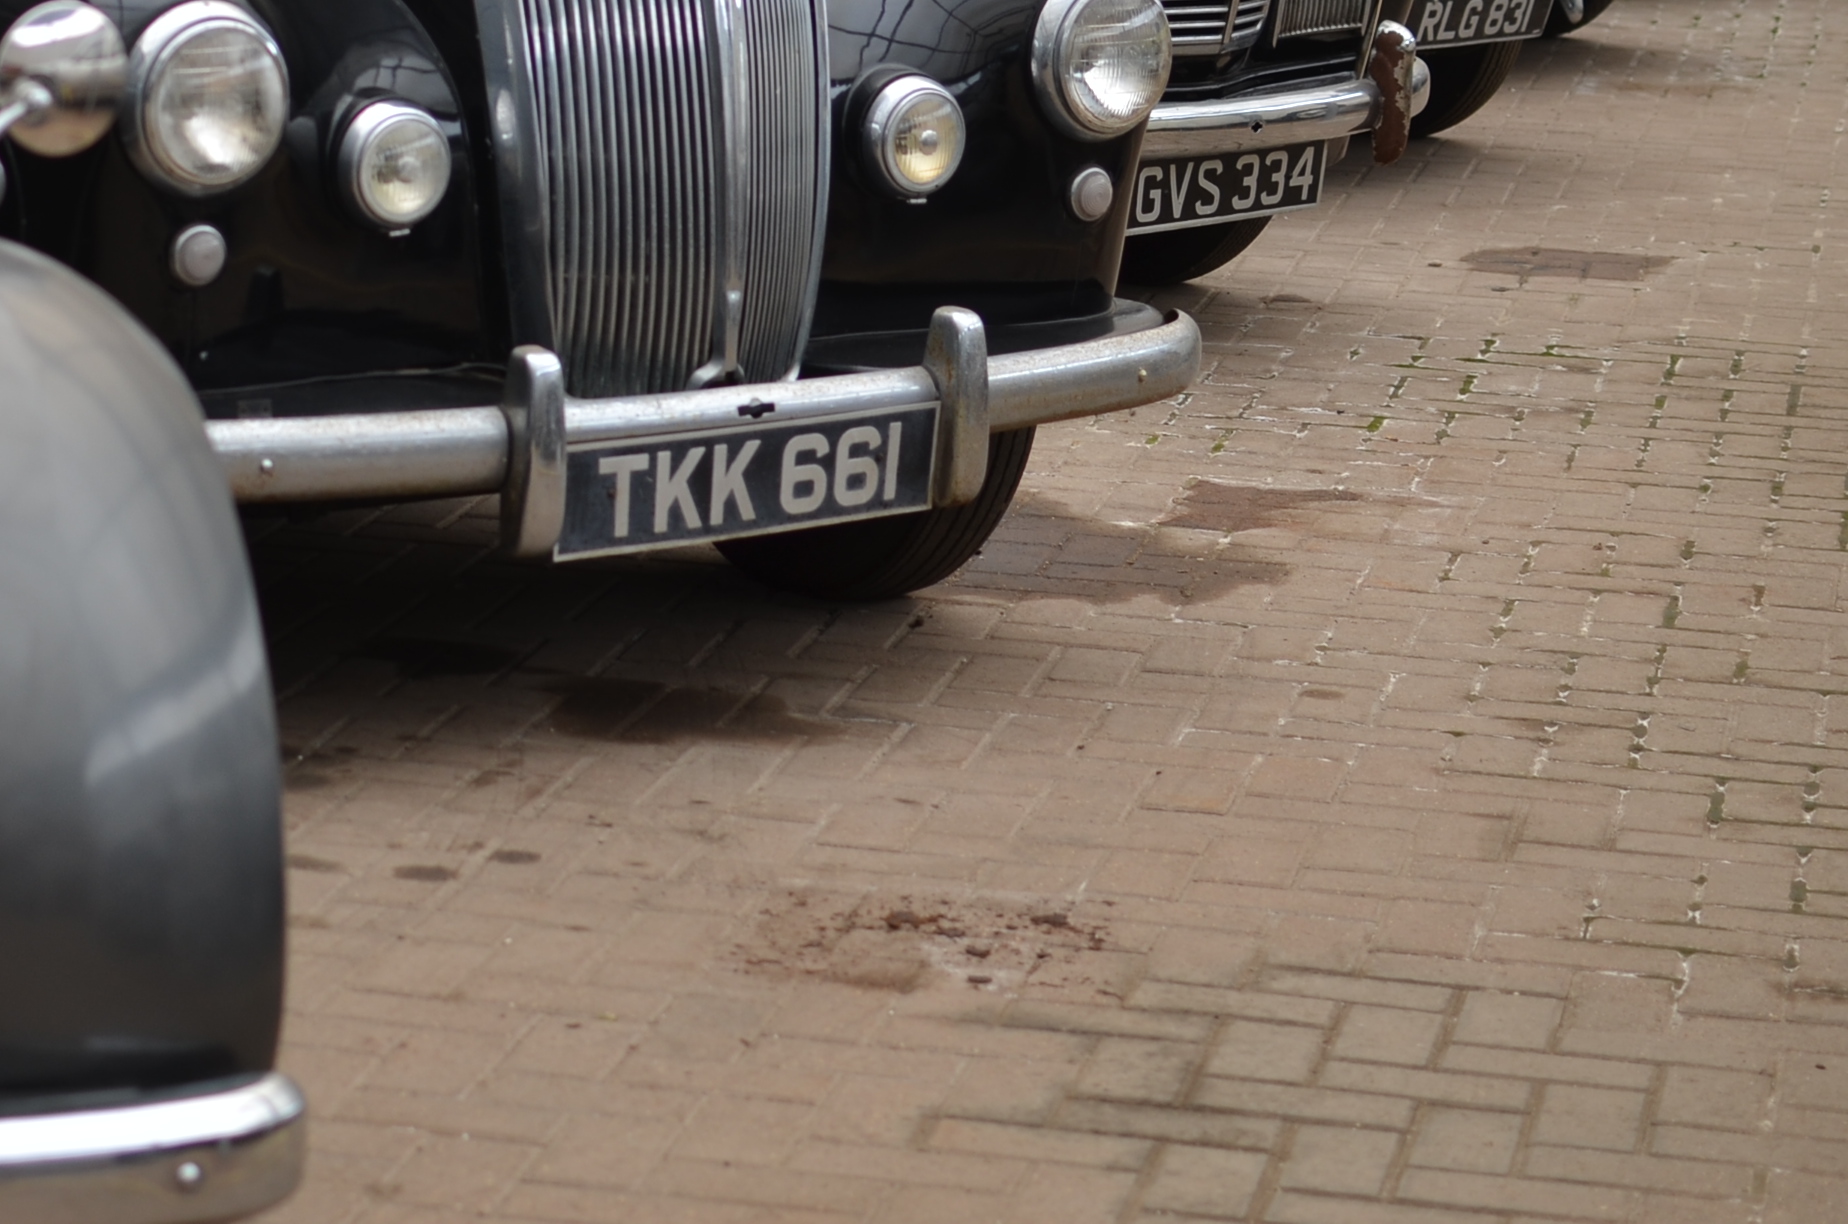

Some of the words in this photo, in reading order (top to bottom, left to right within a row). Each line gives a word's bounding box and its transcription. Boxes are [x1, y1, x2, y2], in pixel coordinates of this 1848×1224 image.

[1136, 159, 1223, 223] GVS
[1232, 146, 1315, 210] 334
[599, 439, 762, 538] TKK
[780, 421, 902, 515] 661
